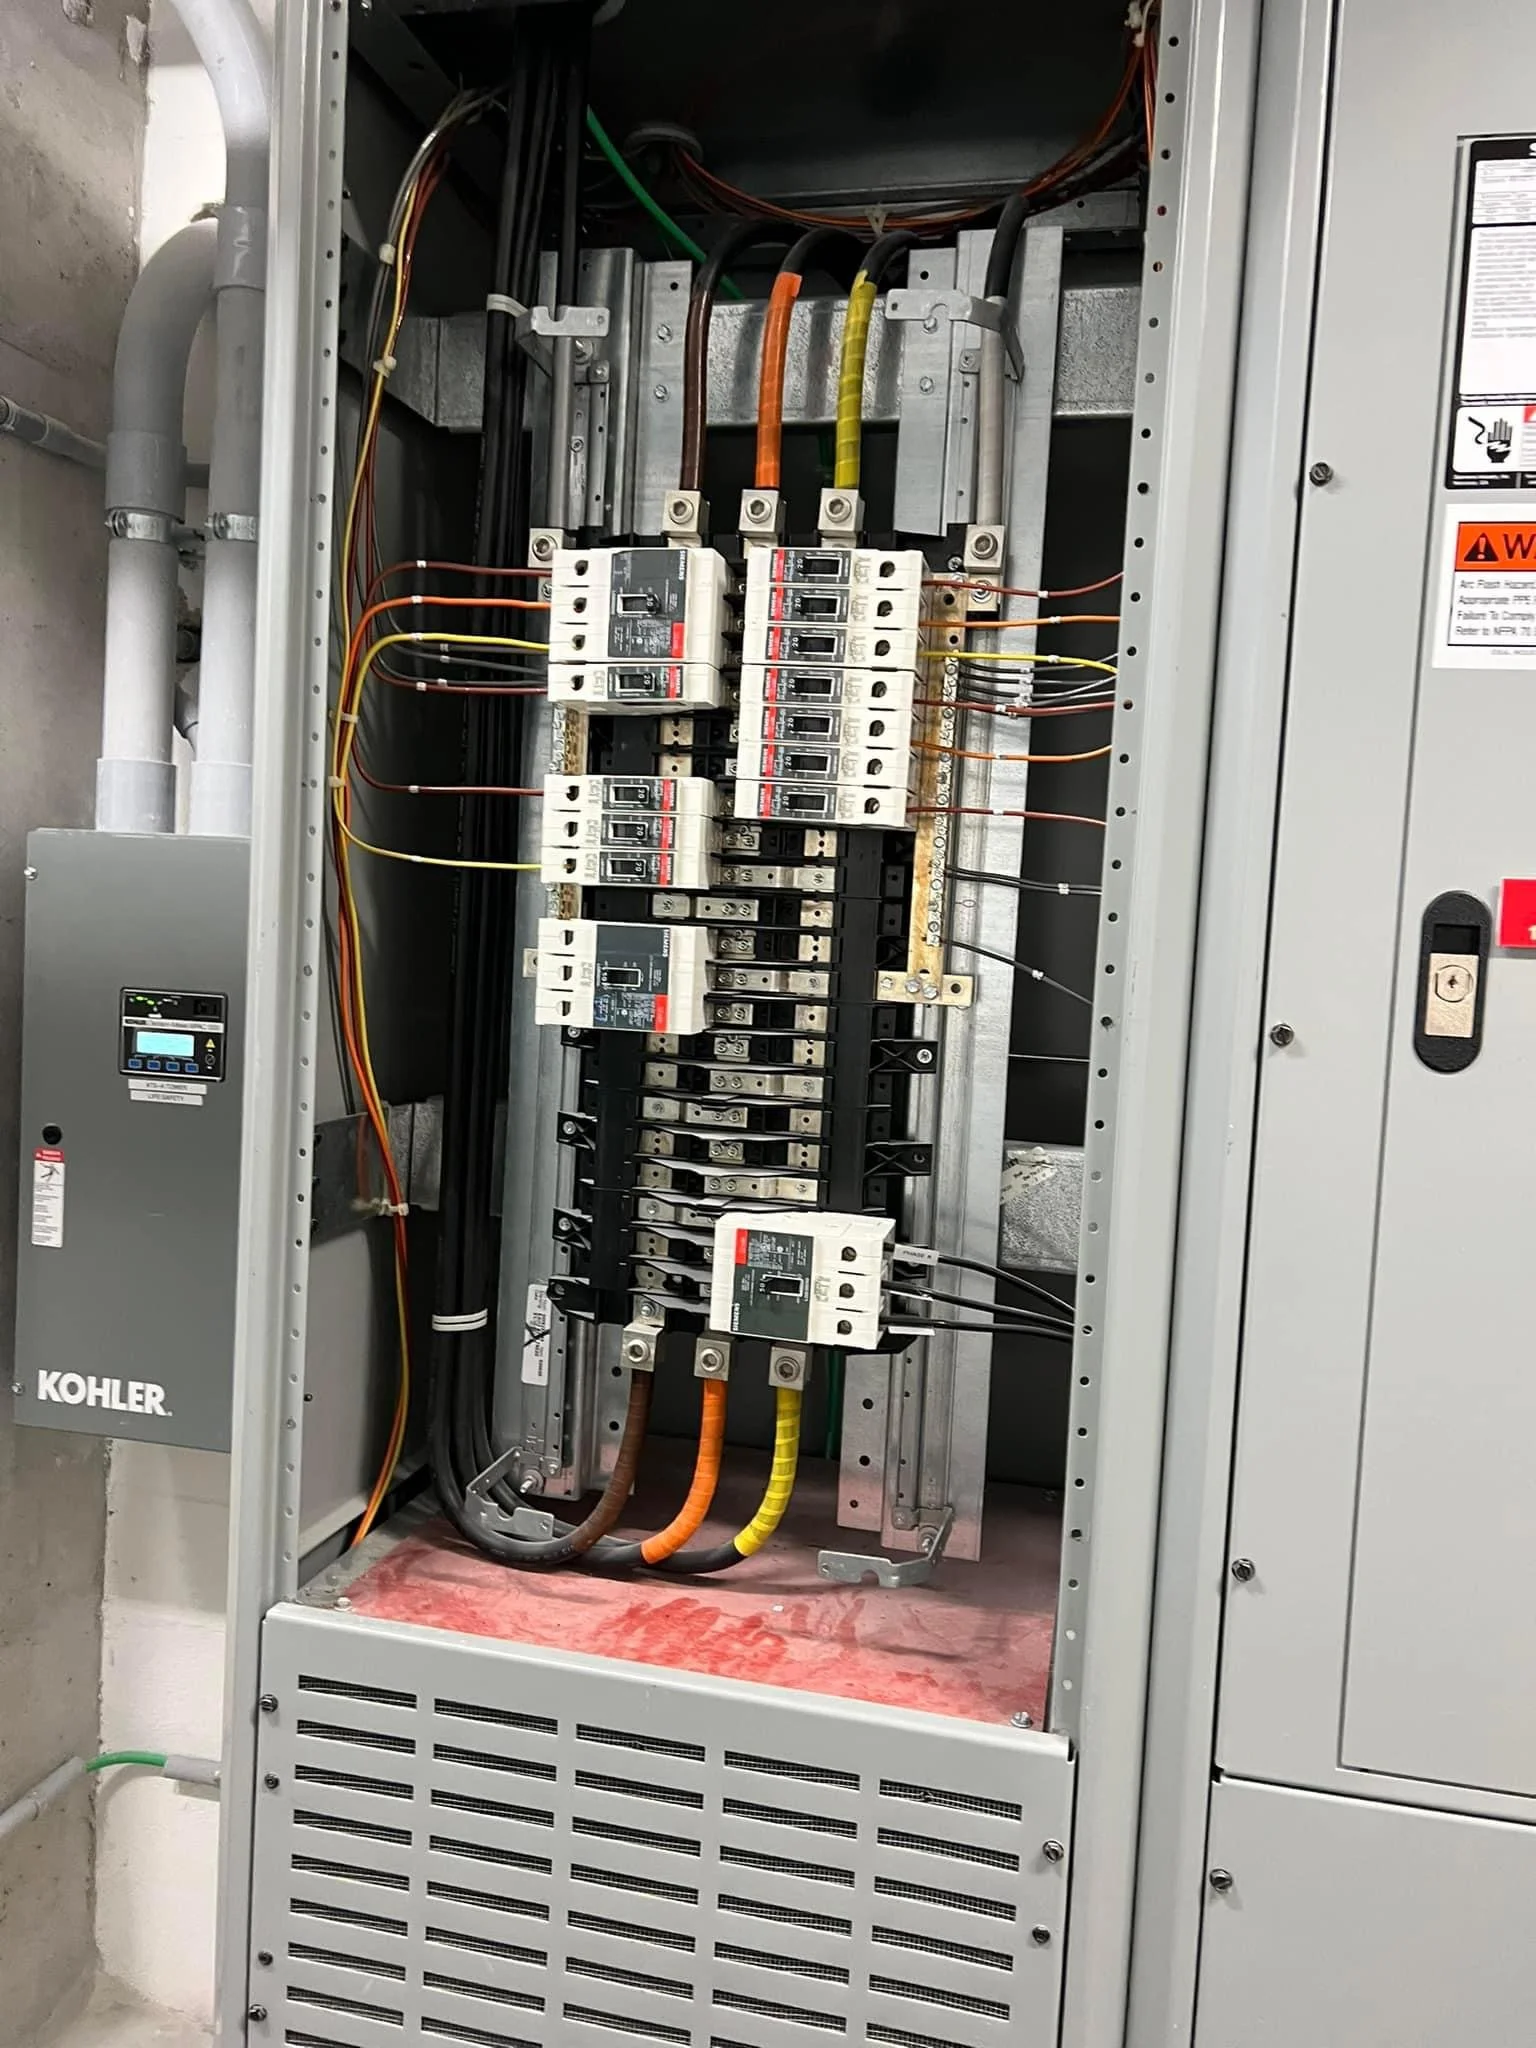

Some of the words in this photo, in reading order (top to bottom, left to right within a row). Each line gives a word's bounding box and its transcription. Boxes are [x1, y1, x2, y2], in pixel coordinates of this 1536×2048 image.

[1503, 533, 1536, 559] W
[678, 550, 686, 580] SIEMENS
[732, 1302, 740, 1331] SIEMENS
[37, 1369, 168, 1416] KOHLER
